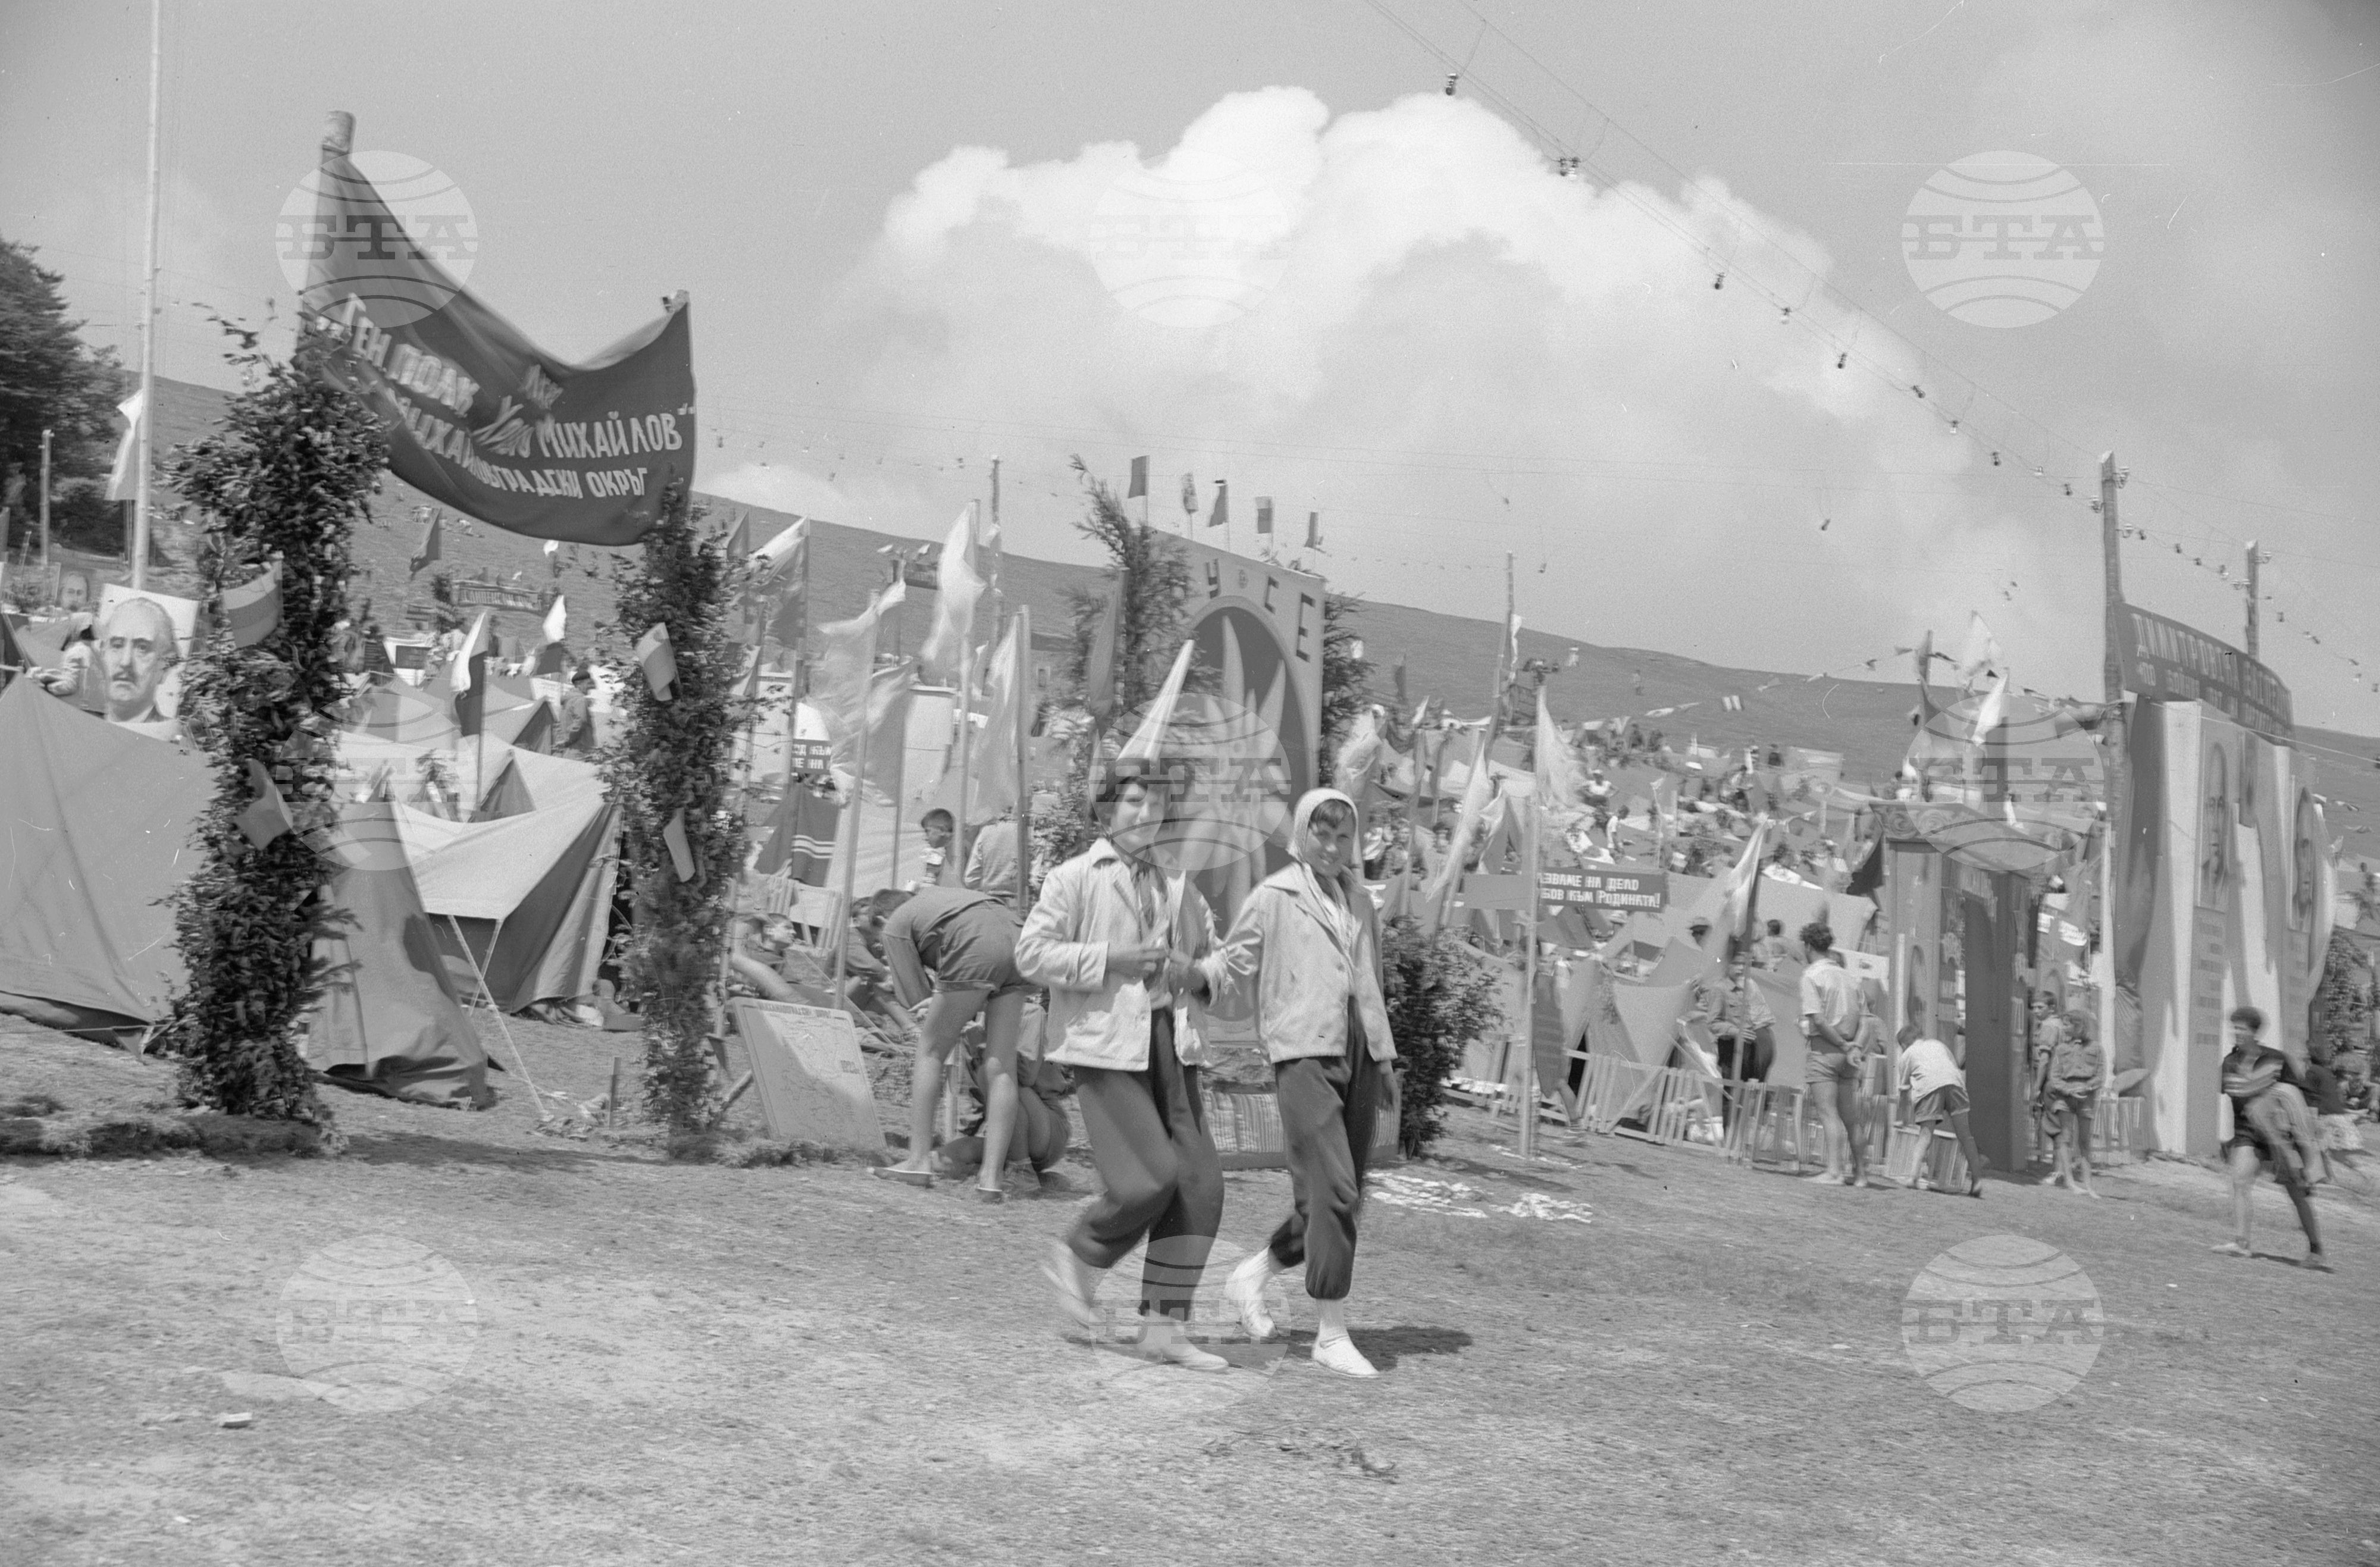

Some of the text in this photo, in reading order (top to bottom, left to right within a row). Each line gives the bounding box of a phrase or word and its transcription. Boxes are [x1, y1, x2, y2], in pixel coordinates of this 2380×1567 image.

[585, 468, 647, 497] ОКРЪГ
[1585, 876, 1601, 888] НА
[1605, 877, 1639, 892] ДЕЛО
[1541, 888, 1564, 900] БОВ
[1567, 889, 1593, 902] КЪМ
